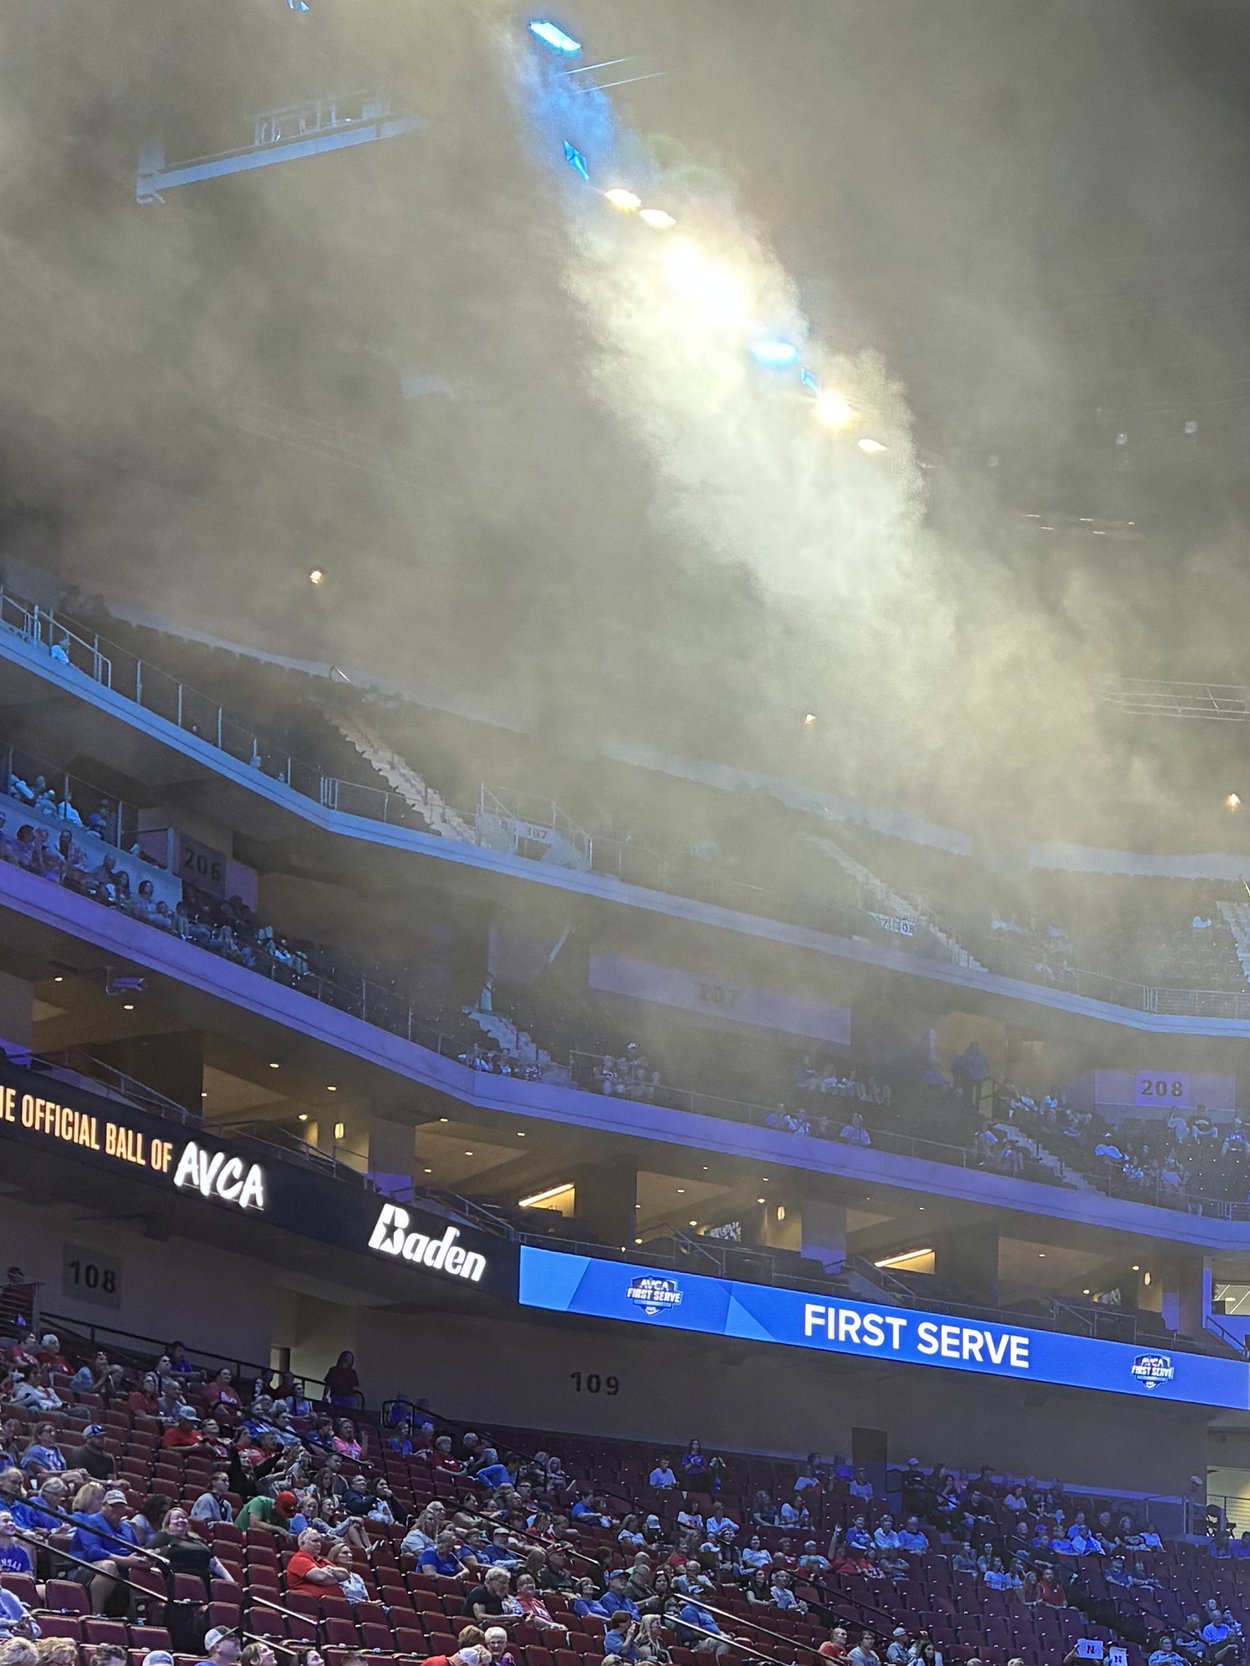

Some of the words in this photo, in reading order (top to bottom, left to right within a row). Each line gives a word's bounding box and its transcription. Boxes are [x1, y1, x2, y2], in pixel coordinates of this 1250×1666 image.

[1142, 1078, 1184, 1099] 208
[21, 1094, 100, 1150] OFFICIAL
[105, 1122, 146, 1166] BALL
[151, 1138, 173, 1173] OF
[174, 1141, 264, 1208] AVCA
[368, 1203, 487, 1282] Baden
[68, 1258, 117, 1294] 108
[640, 1279, 670, 1291] AVCA
[627, 1288, 653, 1299] FIRST
[653, 1290, 681, 1302] SERVE
[804, 1302, 907, 1350] FIRST
[917, 1321, 1030, 1369] SERVE
[571, 1371, 620, 1396] 109
[1087, 1645, 1095, 1654] N
[1114, 1655, 1122, 1663] N
